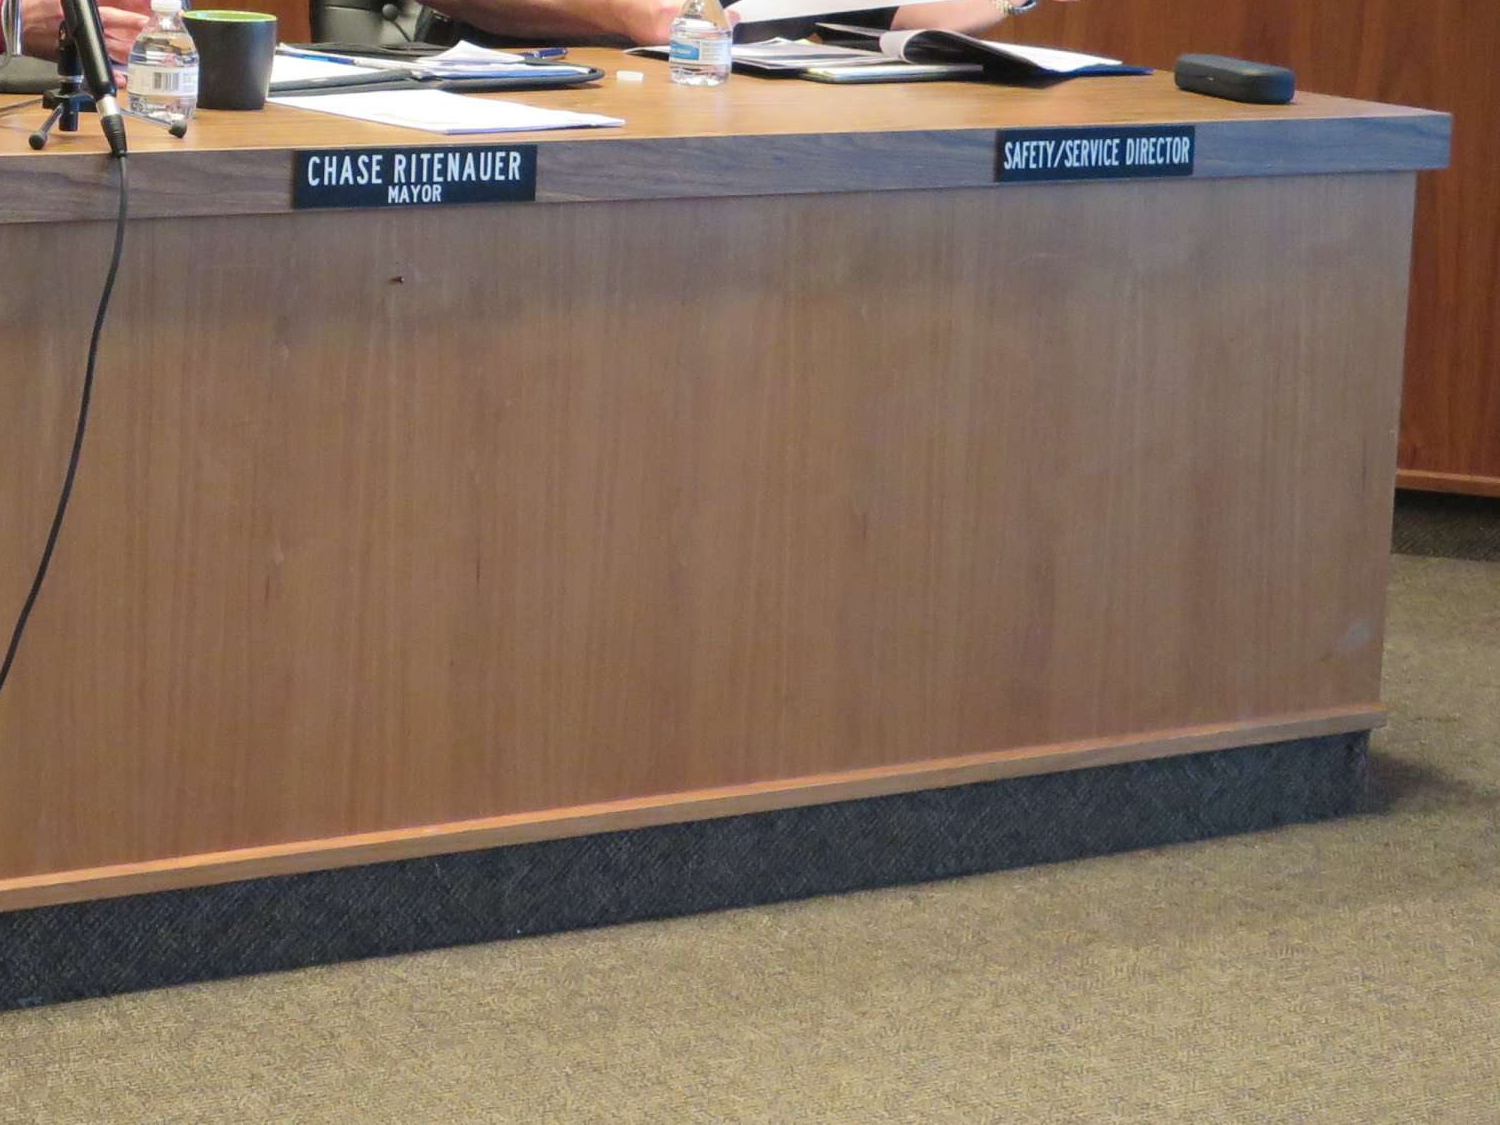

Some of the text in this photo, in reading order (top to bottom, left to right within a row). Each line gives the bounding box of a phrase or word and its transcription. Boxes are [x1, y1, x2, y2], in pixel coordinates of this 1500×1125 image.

[307, 151, 522, 187] CHASE RITENAUER
[1004, 136, 1190, 170] SAFETY/SERVICE DIRECTOR
[387, 184, 442, 204] MAYOR
